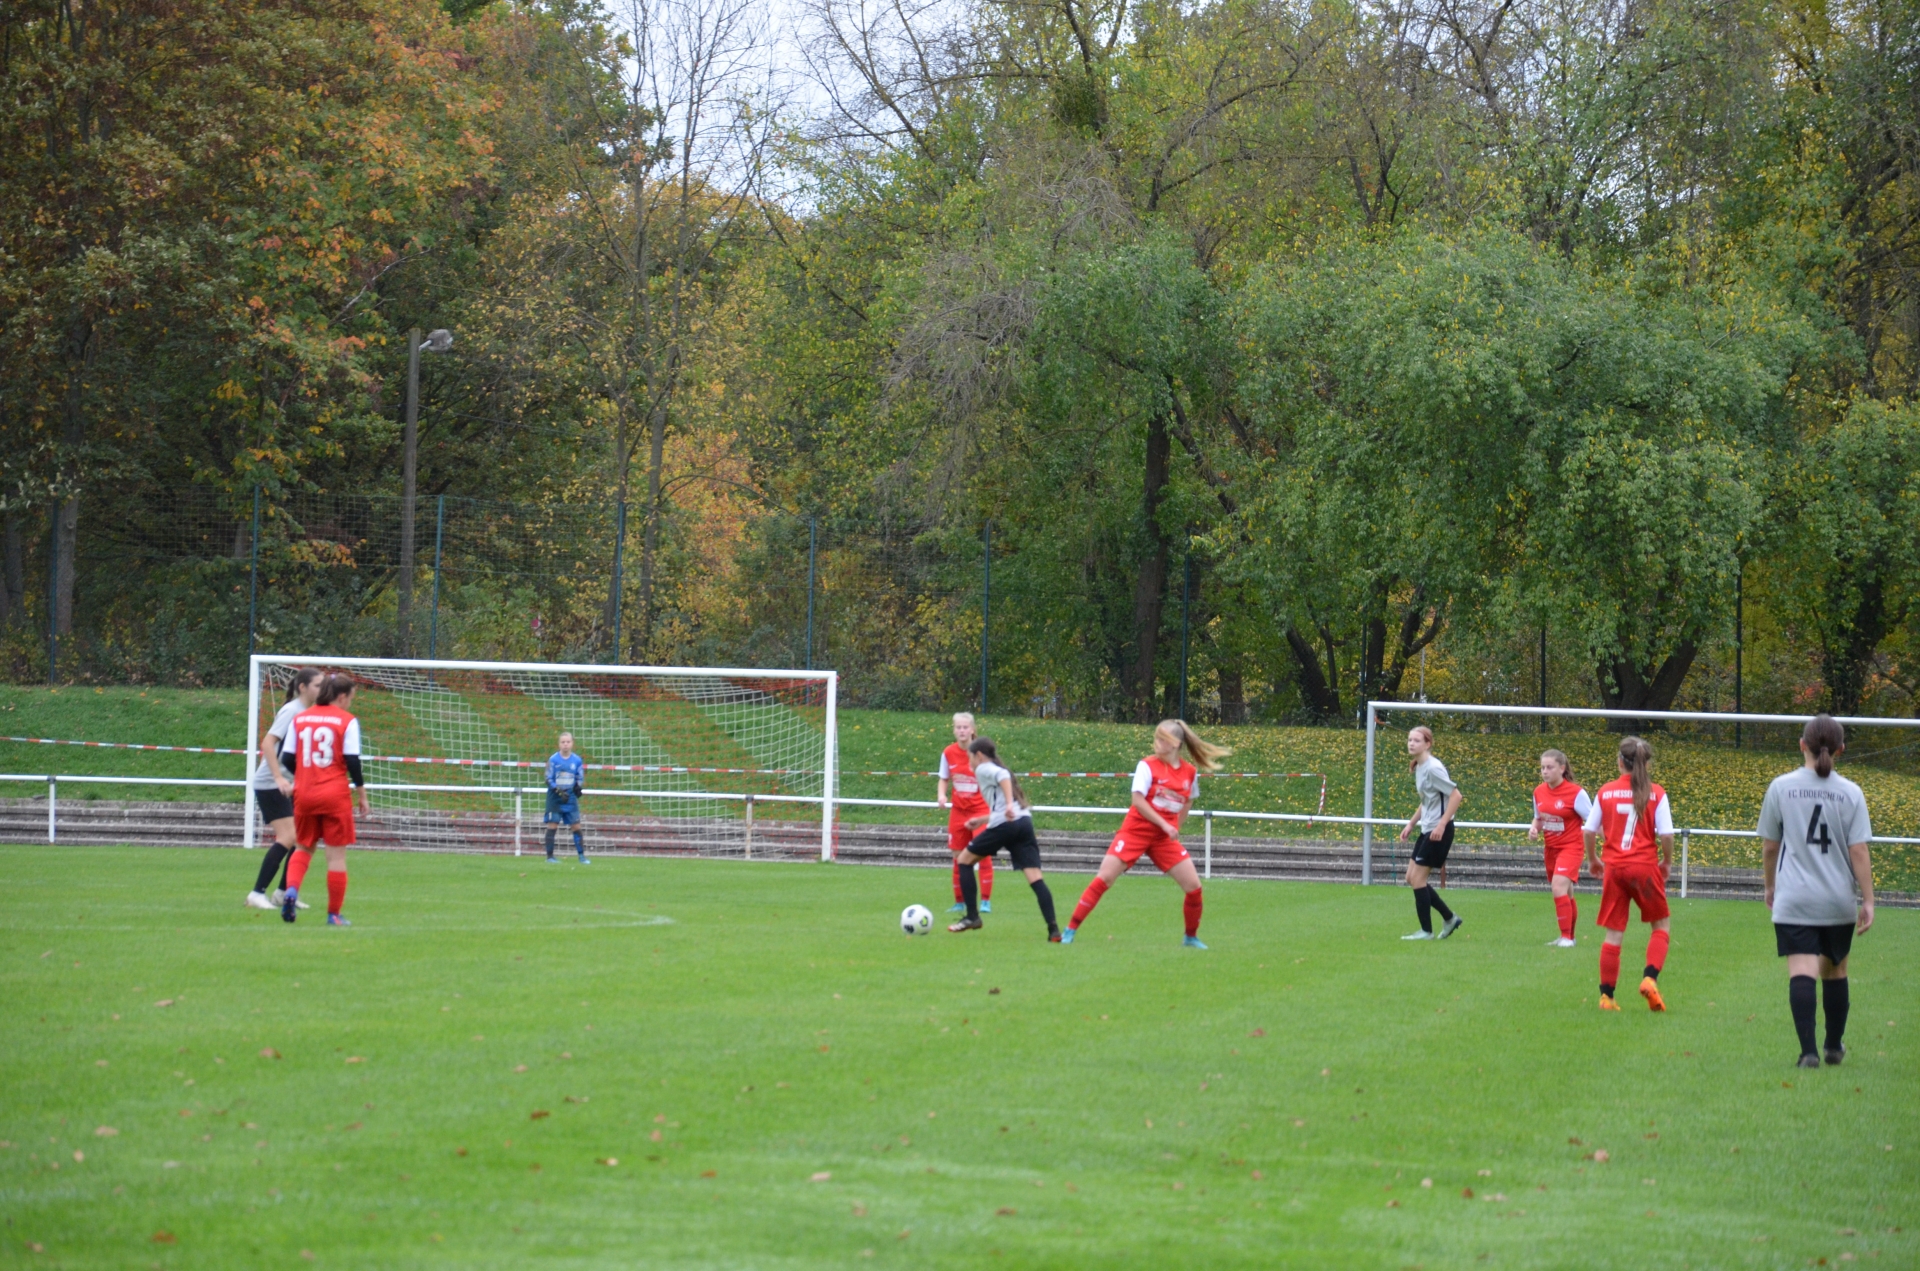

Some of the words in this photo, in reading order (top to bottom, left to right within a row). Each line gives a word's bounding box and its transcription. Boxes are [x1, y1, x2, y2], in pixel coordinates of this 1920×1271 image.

[299, 726, 334, 768] 13
[1788, 789, 1798, 799] FC
[1800, 789, 1845, 804] EDDERSHEIM
[1114, 840, 1125, 852] 3
[1616, 803, 1638, 851] 7
[1806, 804, 1832, 855] 4
